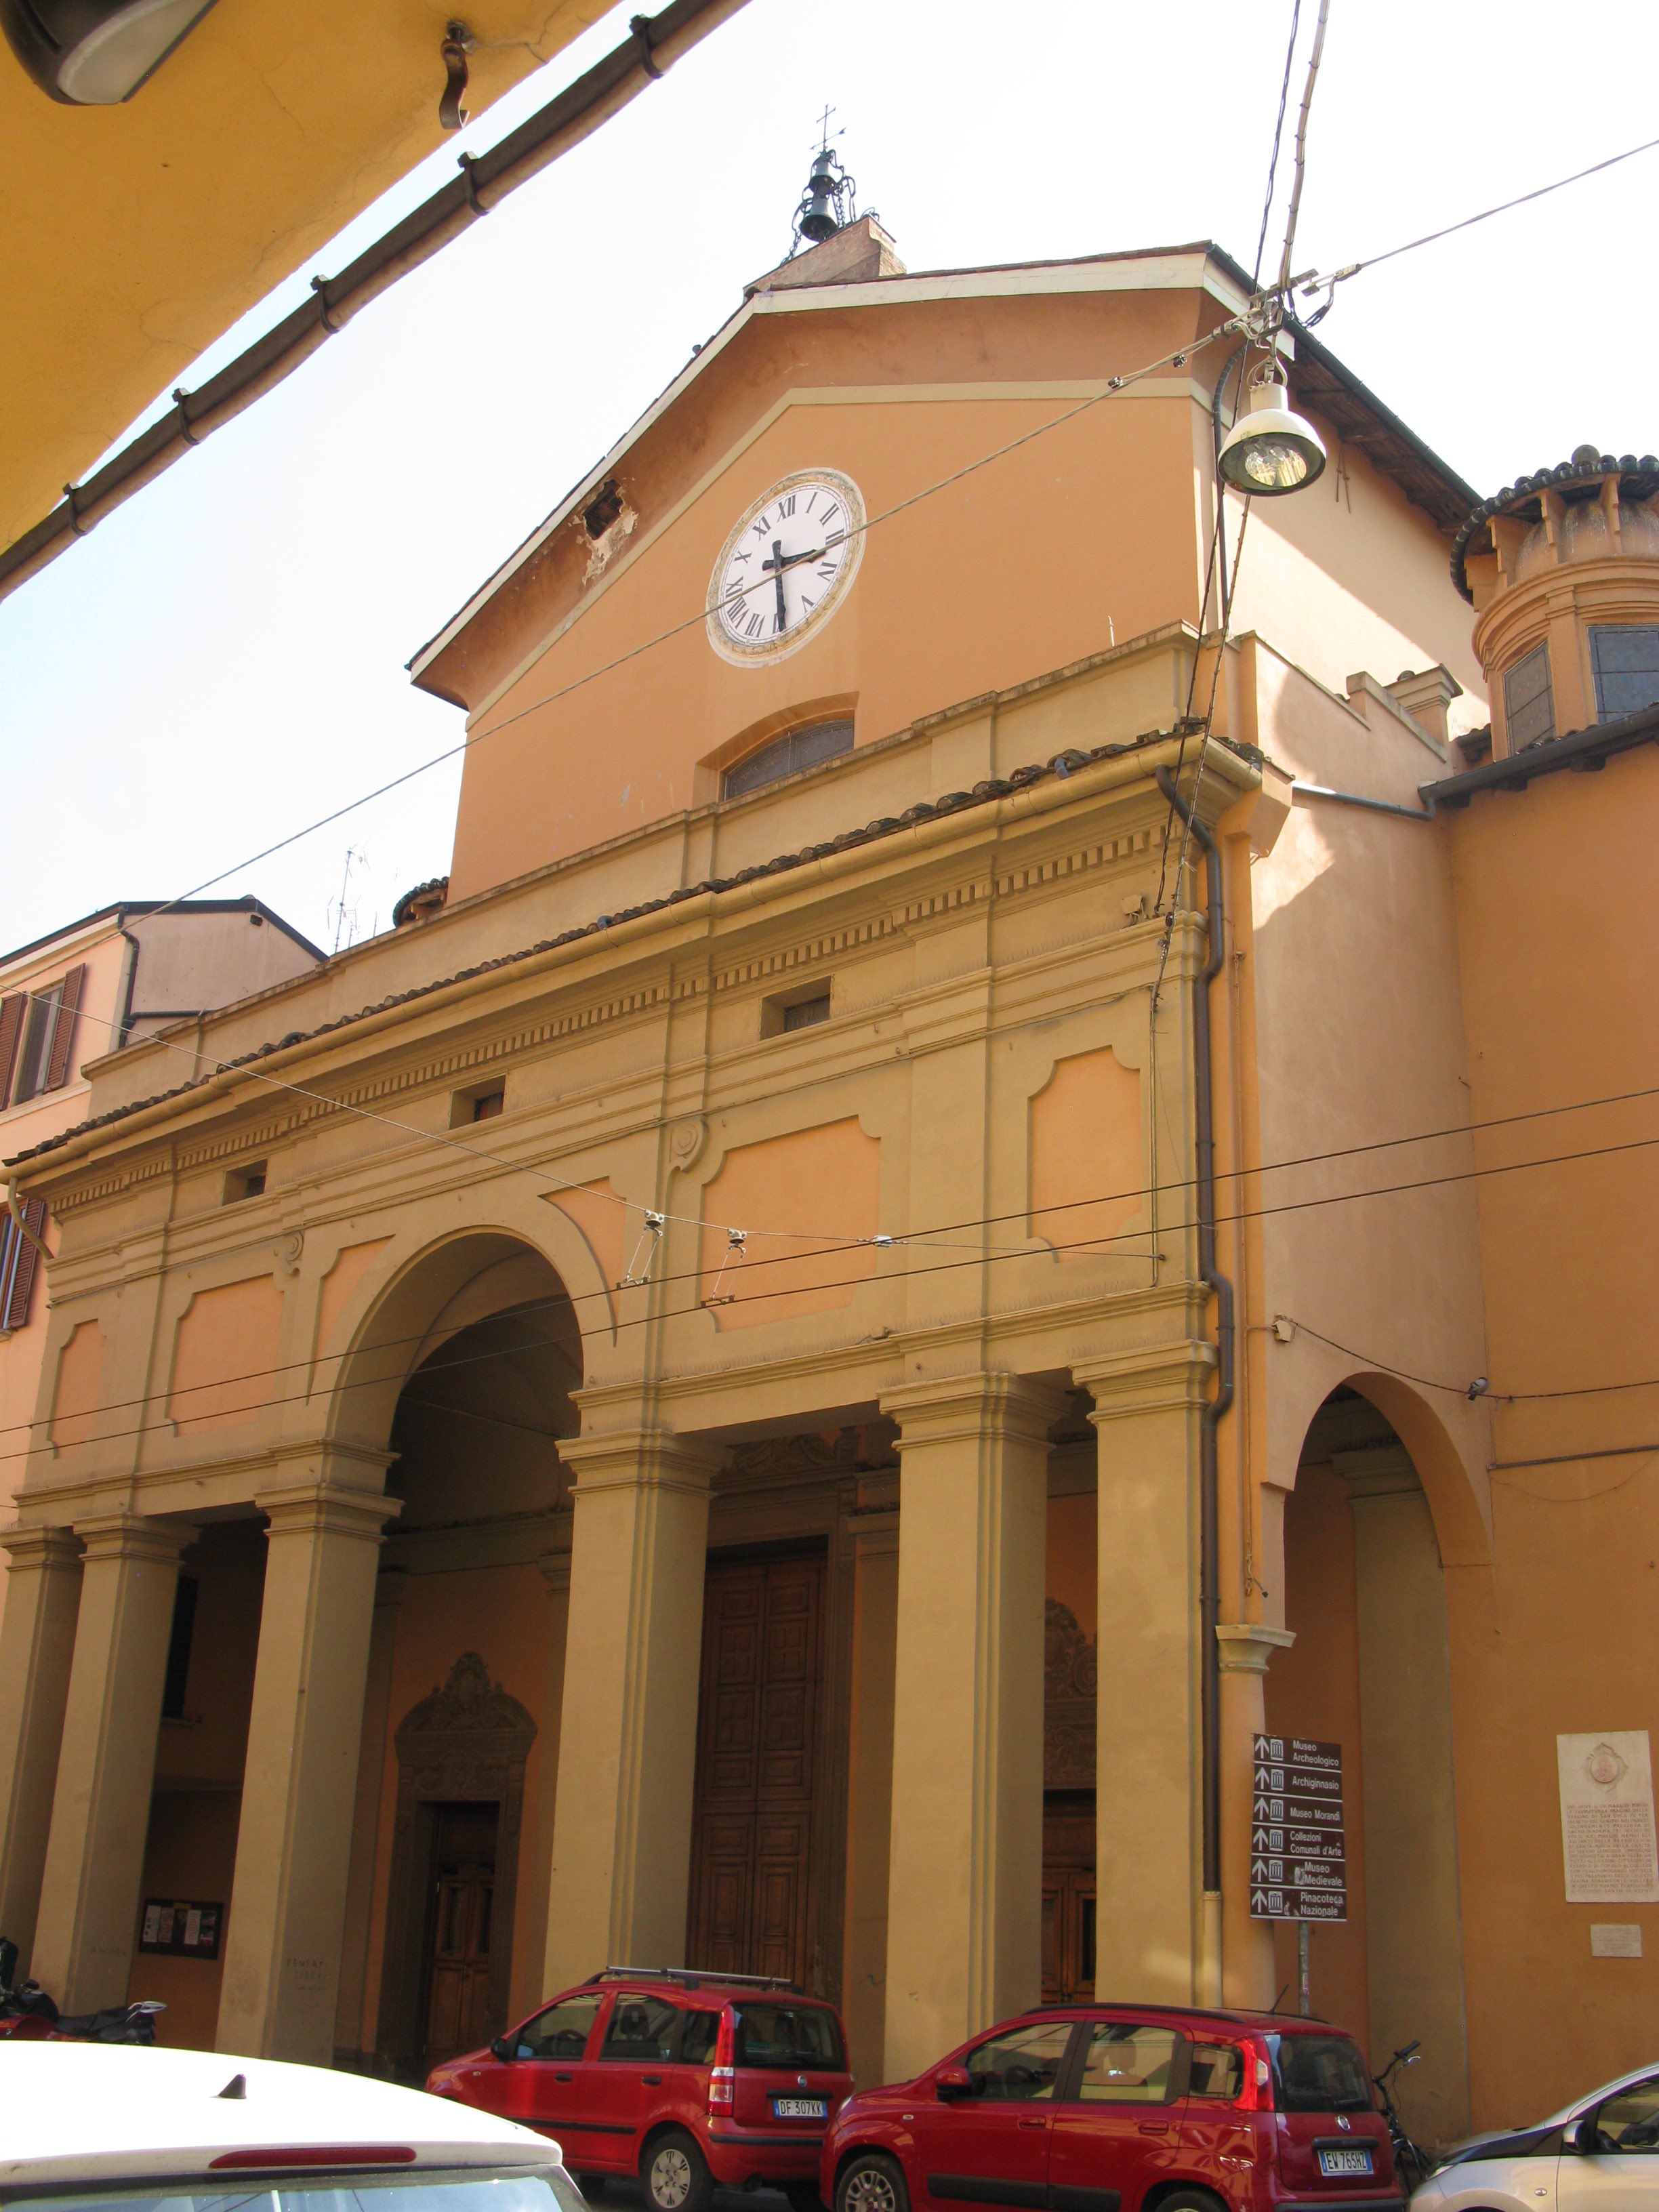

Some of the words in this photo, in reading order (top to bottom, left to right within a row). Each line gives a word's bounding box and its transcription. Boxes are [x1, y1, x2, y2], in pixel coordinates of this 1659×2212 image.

[777, 495, 796, 523] XII
[819, 503, 839, 527] II
[752, 516, 771, 541] XI
[734, 550, 752, 565] X
[725, 576, 743, 598] IX
[801, 595, 815, 613] V
[726, 596, 750, 629] VIII
[745, 613, 765, 638] VII
[1293, 1740, 1317, 1752] Museo
[1293, 1752, 1339, 1767] Archeologico
[1292, 1775, 1339, 1790] Archiginnasio
[1290, 1807, 1312, 1819] Museo
[1315, 1809, 1340, 1821] Morandi
[1290, 1830, 1322, 1843] Collezioni
[1290, 1843, 1320, 1855] Comunali
[1323, 1845, 1341, 1856] d'Arte
[1305, 1862, 1330, 1874] Museo
[1305, 1875, 1342, 1887] Medievale
[1301, 1892, 1343, 1905] Pinacoteca
[1301, 1904, 1338, 1917] Nazionale
[781, 2101, 791, 2114] DF
[795, 2101, 822, 2115] 307KK
[1326, 2152, 1339, 2169] EW
[1340, 2152, 1366, 2169] 765HZ
